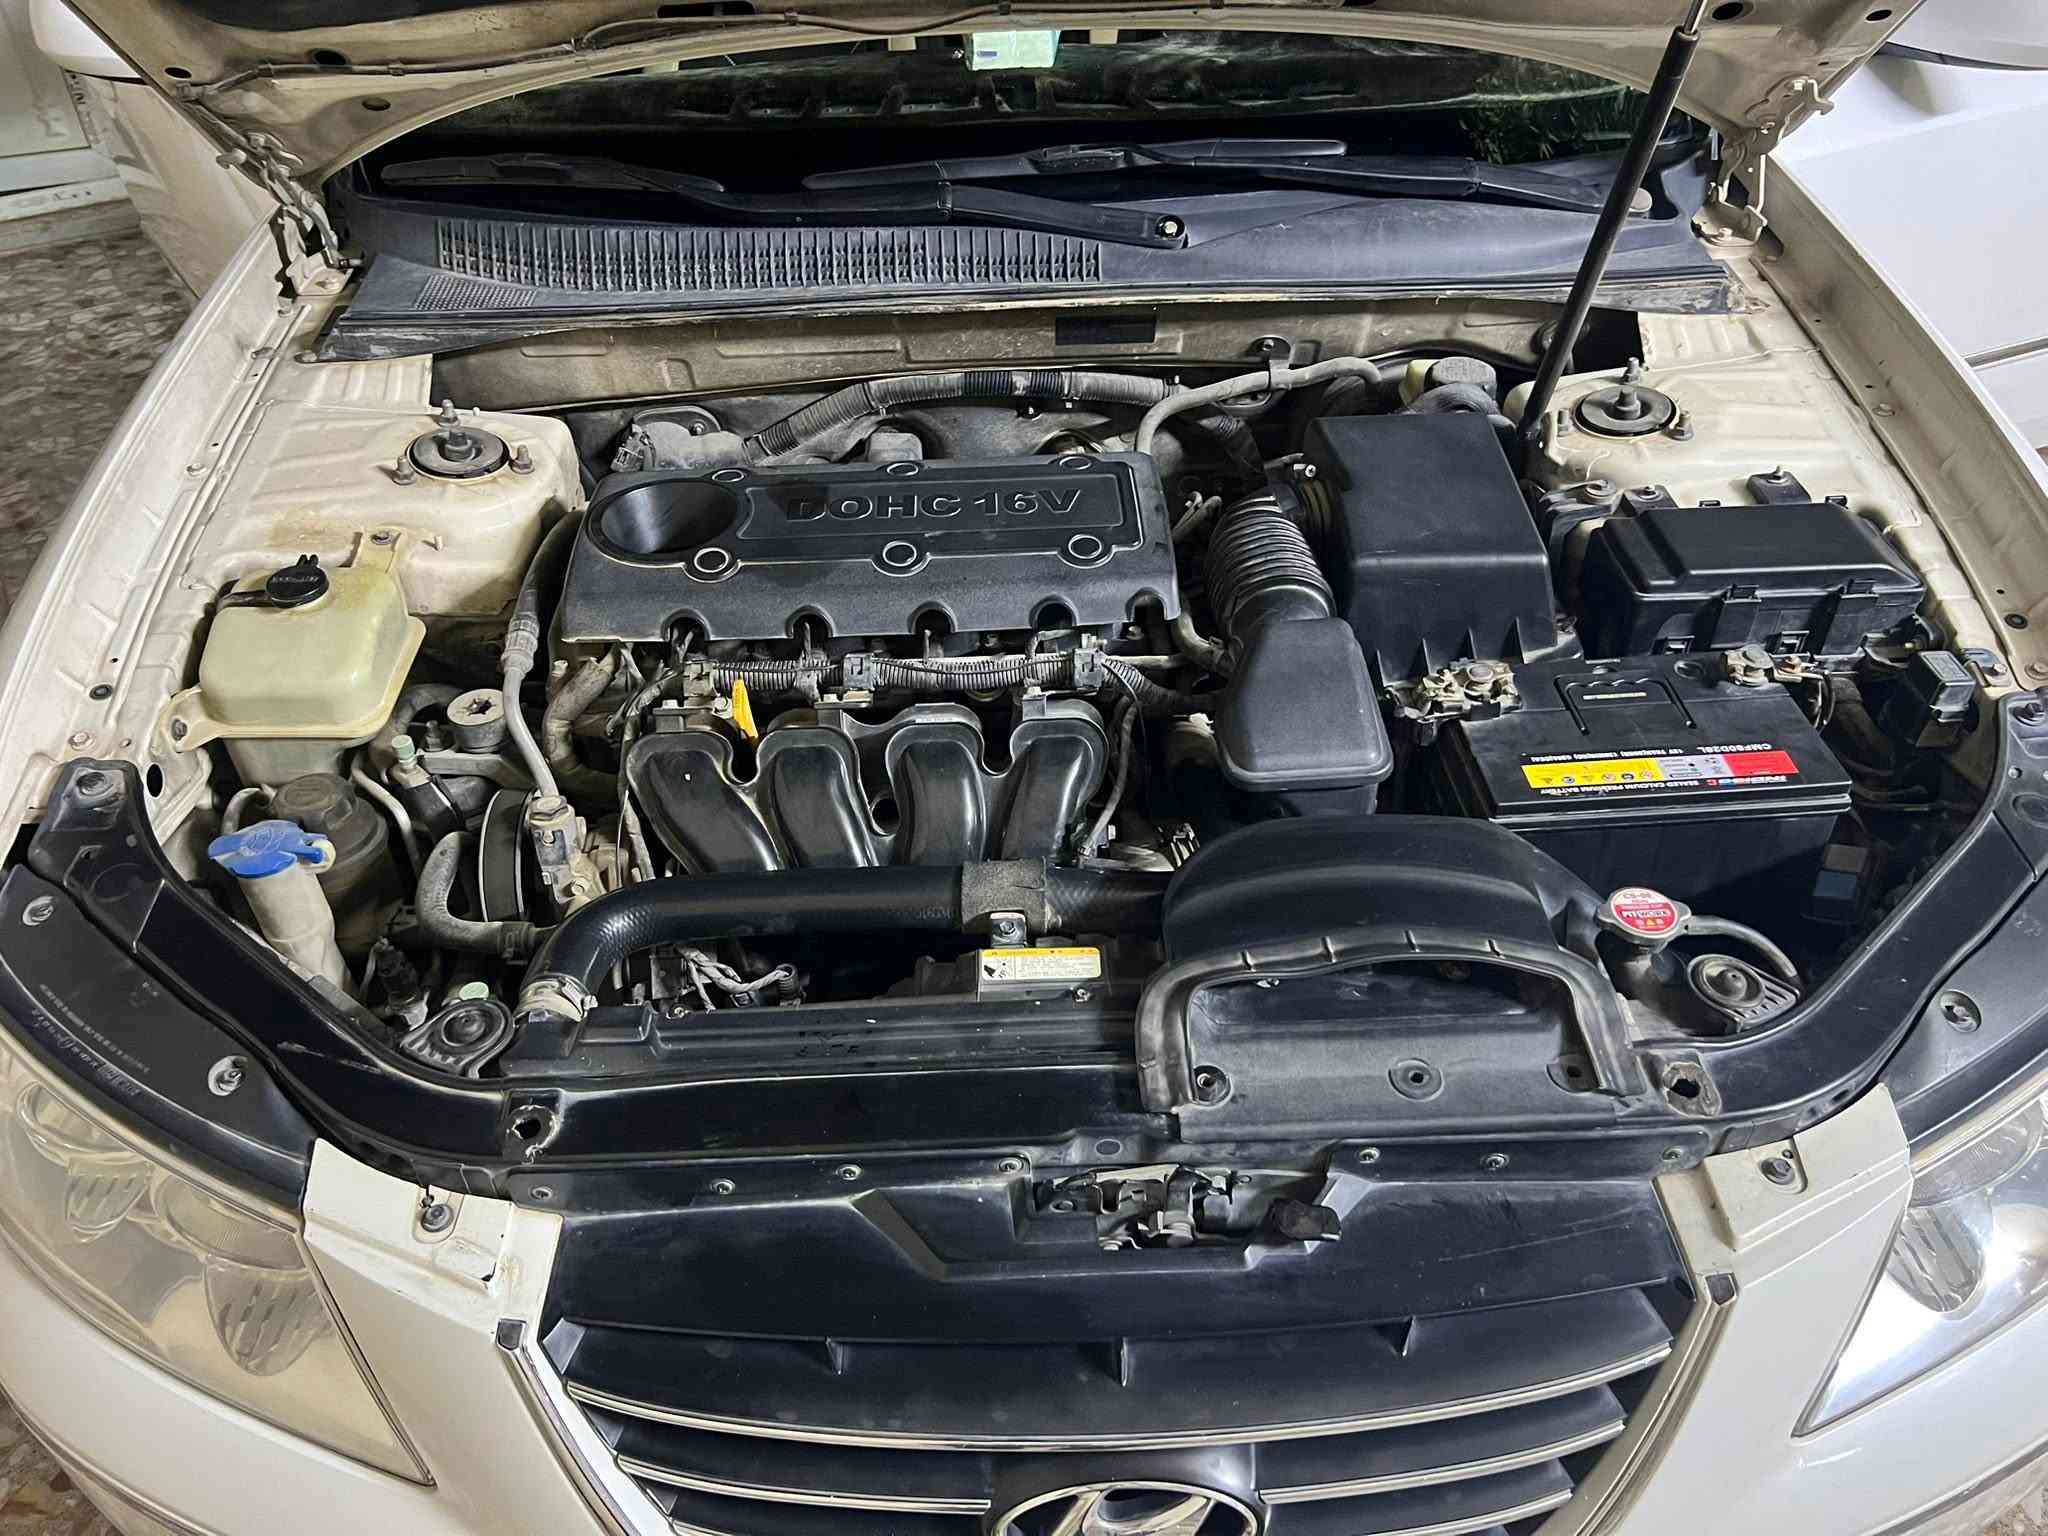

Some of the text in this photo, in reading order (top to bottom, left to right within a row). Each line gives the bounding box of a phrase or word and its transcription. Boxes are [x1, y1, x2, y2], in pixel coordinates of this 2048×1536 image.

[785, 488, 1080, 521] DOHC 16V
[1624, 781, 1666, 790] CALCIUM
[1666, 779, 1700, 787] SEALED
[1540, 786, 1580, 795] BATTERY
[1580, 784, 1624, 793] PREMIUM
